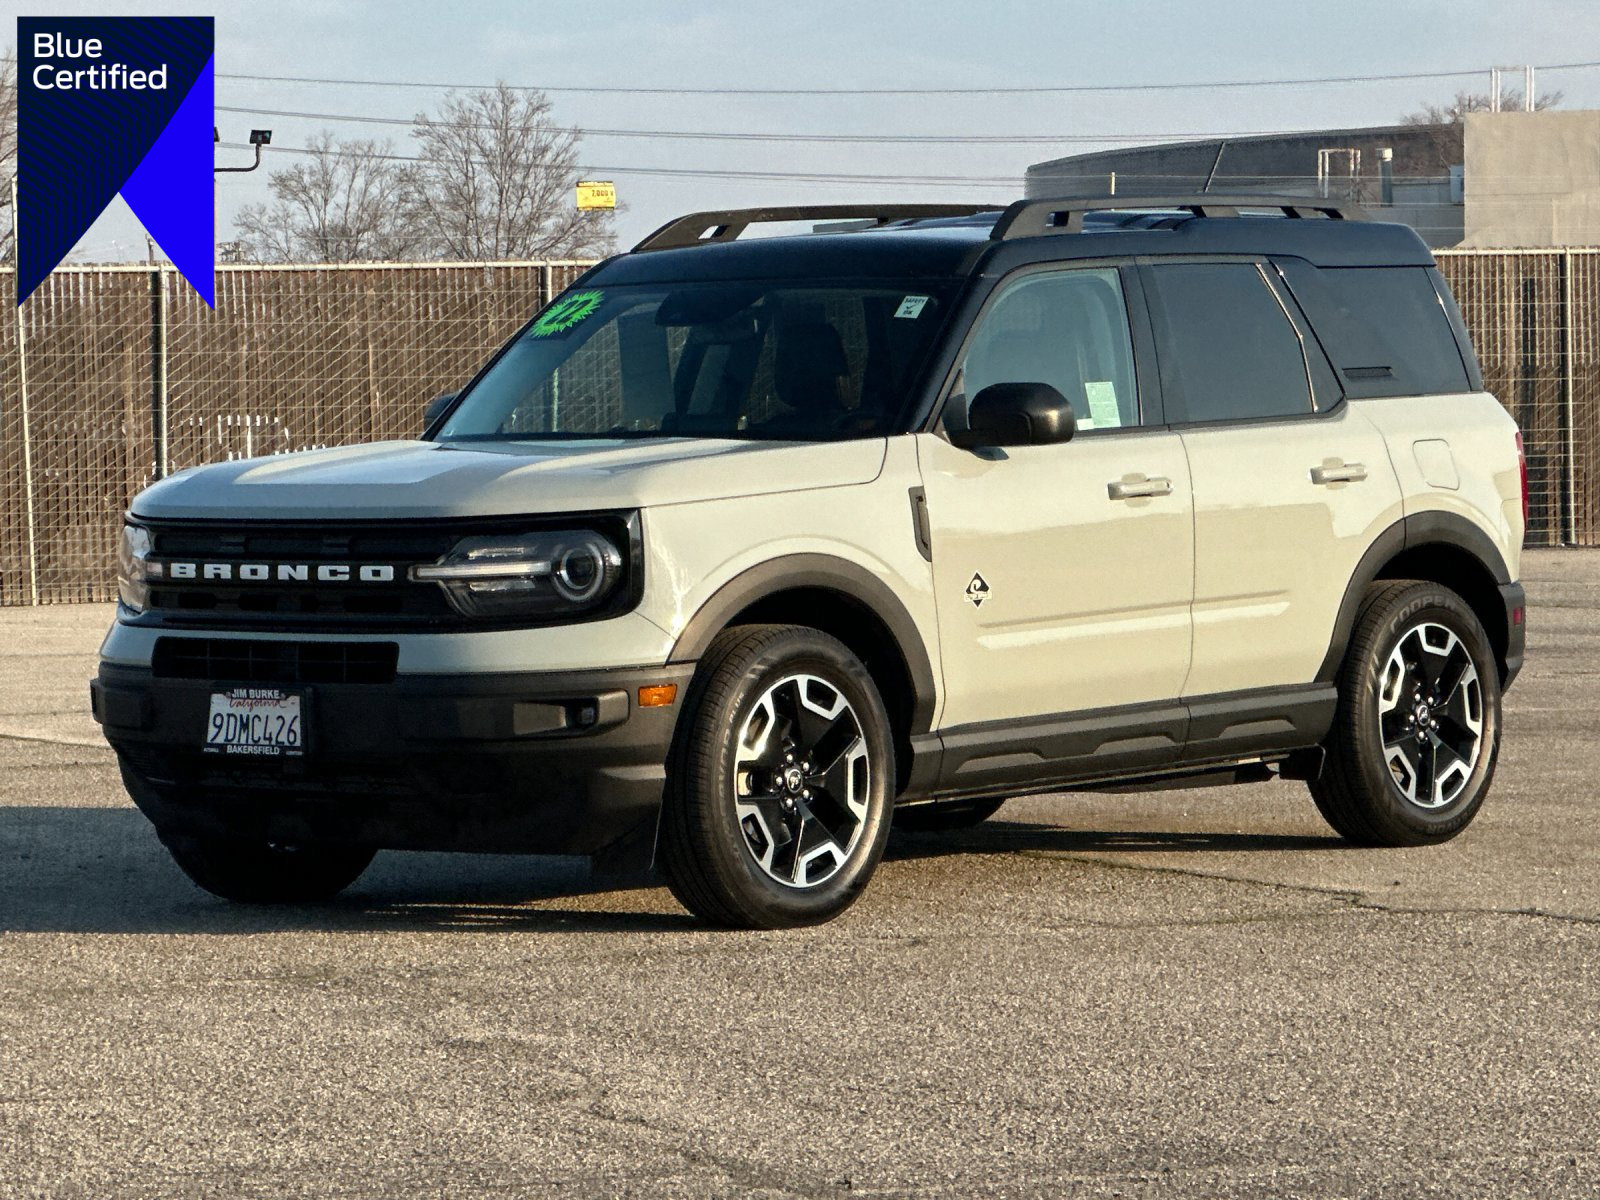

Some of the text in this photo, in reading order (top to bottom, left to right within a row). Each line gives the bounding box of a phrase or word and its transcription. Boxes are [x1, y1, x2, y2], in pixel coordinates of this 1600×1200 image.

[170, 562, 394, 581] BRONCO
[232, 688, 280, 700] JIM BURKE
[210, 712, 299, 746] 9DMC426
[226, 744, 280, 756] BAKERSFIELD
